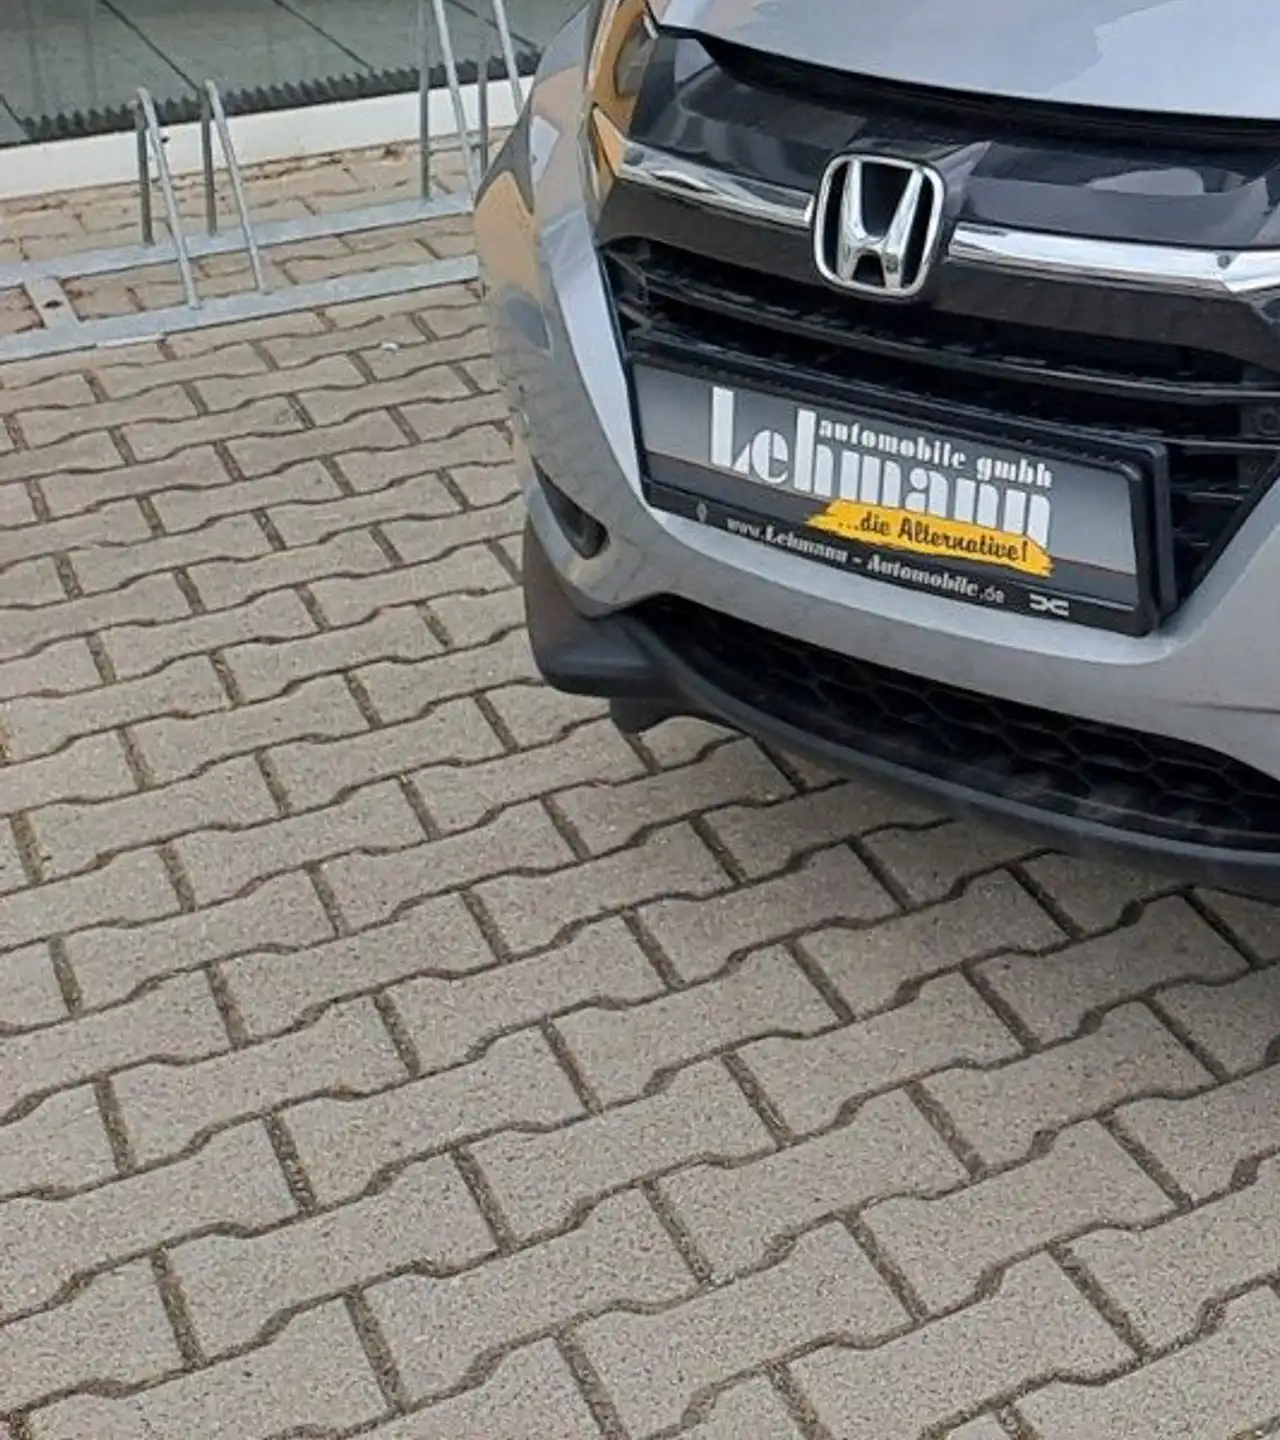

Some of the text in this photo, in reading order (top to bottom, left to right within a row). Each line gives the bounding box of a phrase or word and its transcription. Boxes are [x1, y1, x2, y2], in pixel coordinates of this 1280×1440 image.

[711, 386, 1051, 550] Lehmann
[818, 419, 1053, 489] automobile gmbh
[898, 516, 1029, 563] Alternative!
[866, 554, 1005, 604] Automobile.de
